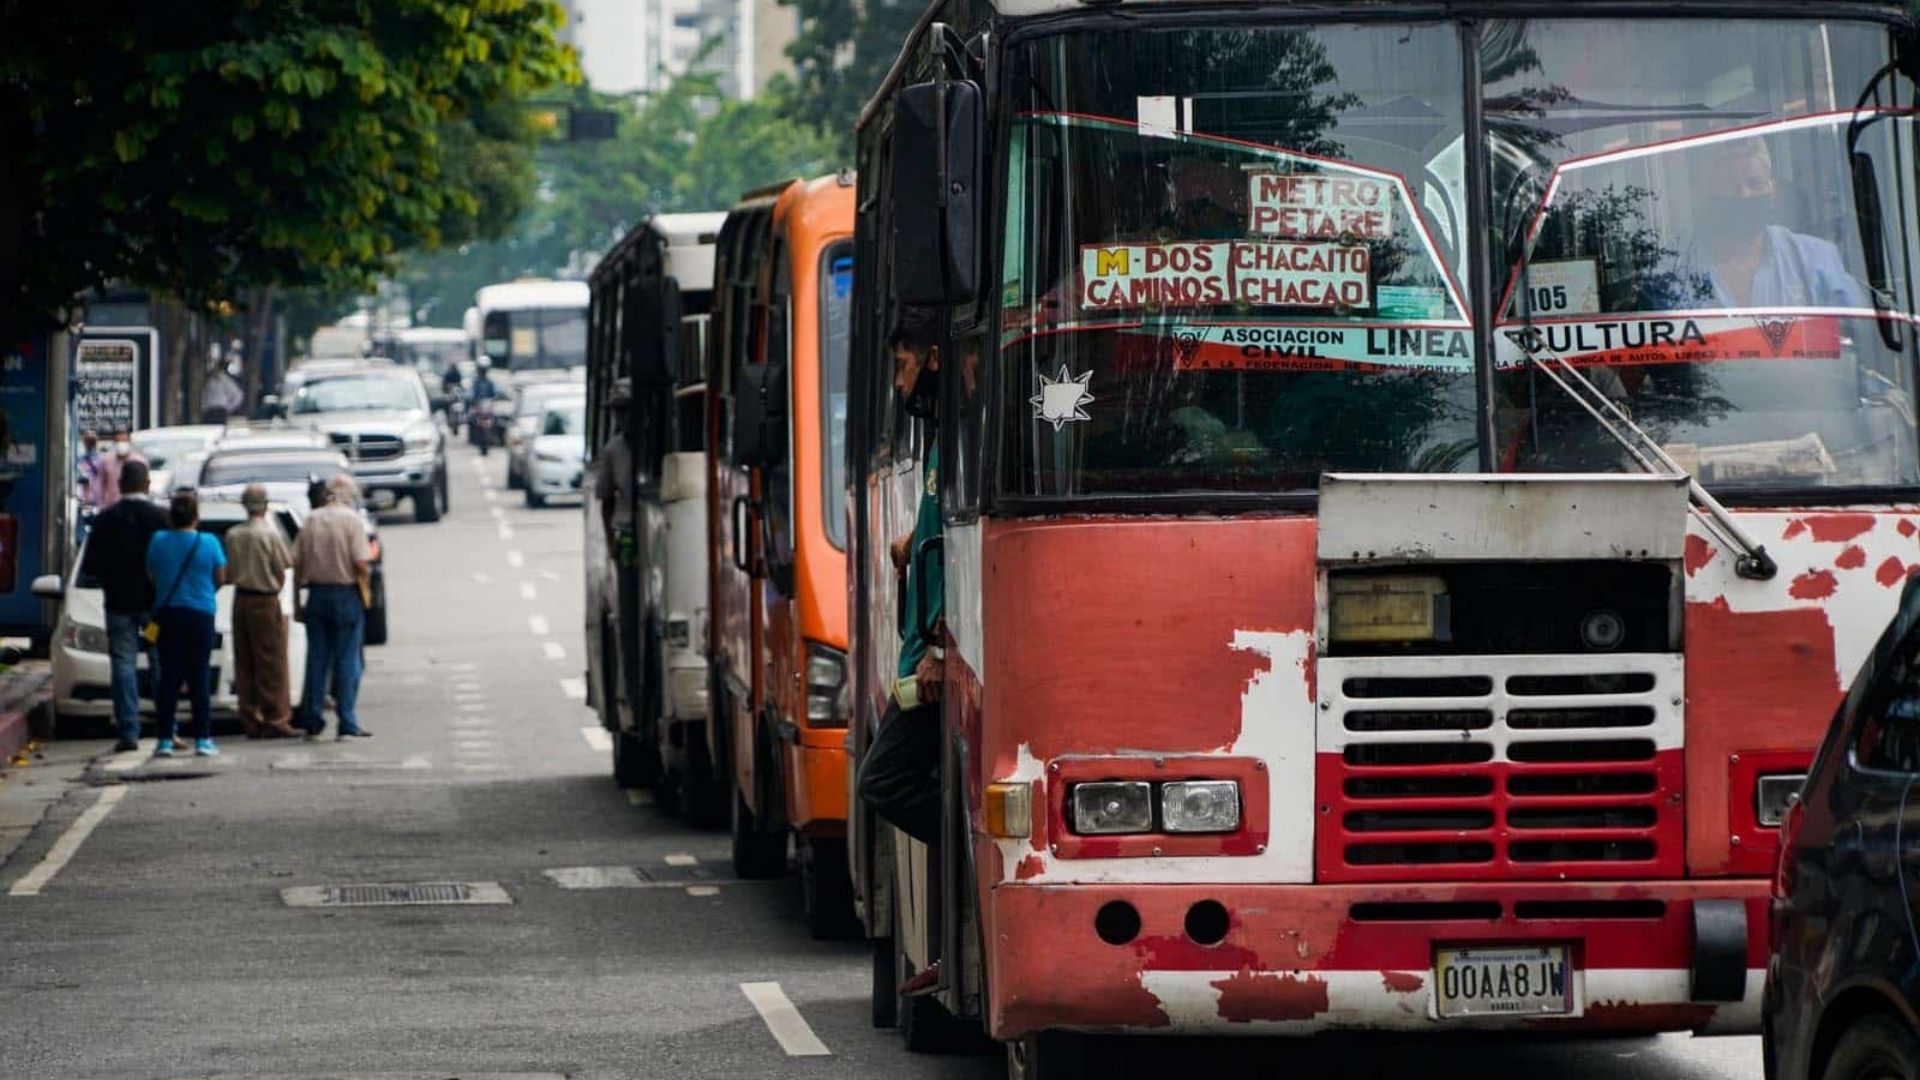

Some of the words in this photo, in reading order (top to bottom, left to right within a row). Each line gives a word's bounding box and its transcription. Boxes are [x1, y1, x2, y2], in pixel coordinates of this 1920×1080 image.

[1259, 176, 1380, 206] METRO
[1254, 206, 1384, 237] PETARE
[1235, 246, 1368, 275] CHACAITO
[1086, 275, 1224, 307] CAMINOS
[1241, 275, 1363, 305] CHACAO
[1528, 285, 1567, 312] 105
[1222, 328, 1344, 345] ASOCIACION
[1241, 344, 1326, 359] CIVIL
[1366, 328, 1470, 358] LINEA
[1517, 320, 1707, 354] CULTURA
[1631, 353, 1666, 361] AUTOS
